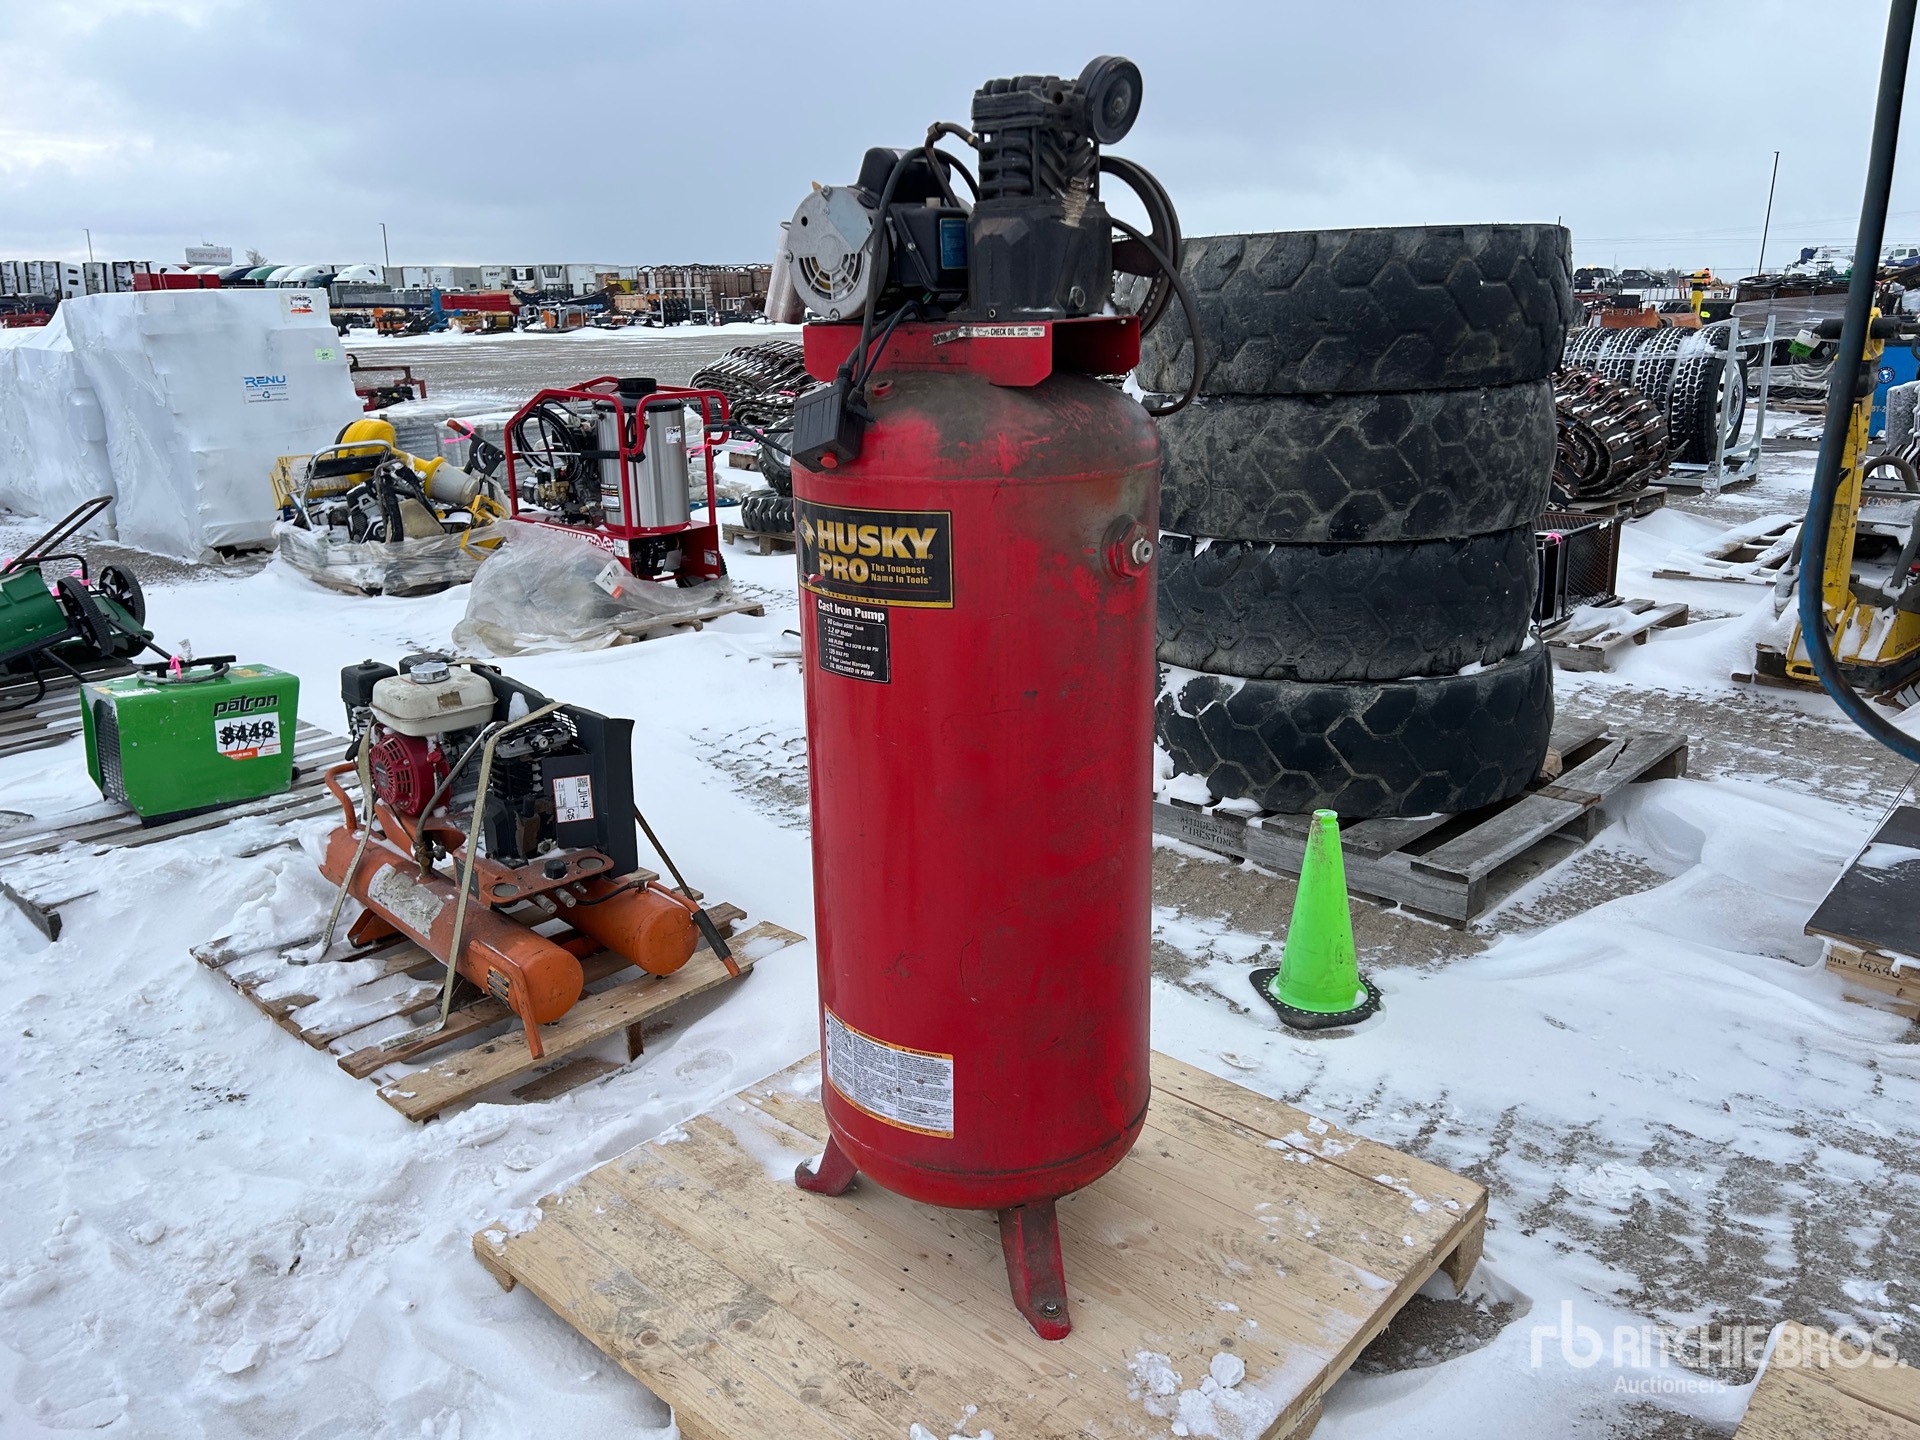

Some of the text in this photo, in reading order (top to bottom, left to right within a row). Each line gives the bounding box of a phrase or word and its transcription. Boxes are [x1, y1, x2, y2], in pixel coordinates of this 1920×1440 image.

[990, 327, 1006, 336] CHECK
[1008, 327, 1016, 336] OIL
[244, 376, 286, 387] RENU
[816, 518, 938, 559] HUSKY
[818, 551, 870, 584] PRO
[871, 563, 925, 574] The Toughest
[871, 573, 929, 585] Name In Tools
[818, 599, 885, 623] Cast Iron Pump
[852, 661, 871, 670] Warranty
[214, 695, 278, 716] patron
[1182, 825, 1234, 848] FIRESTONE
